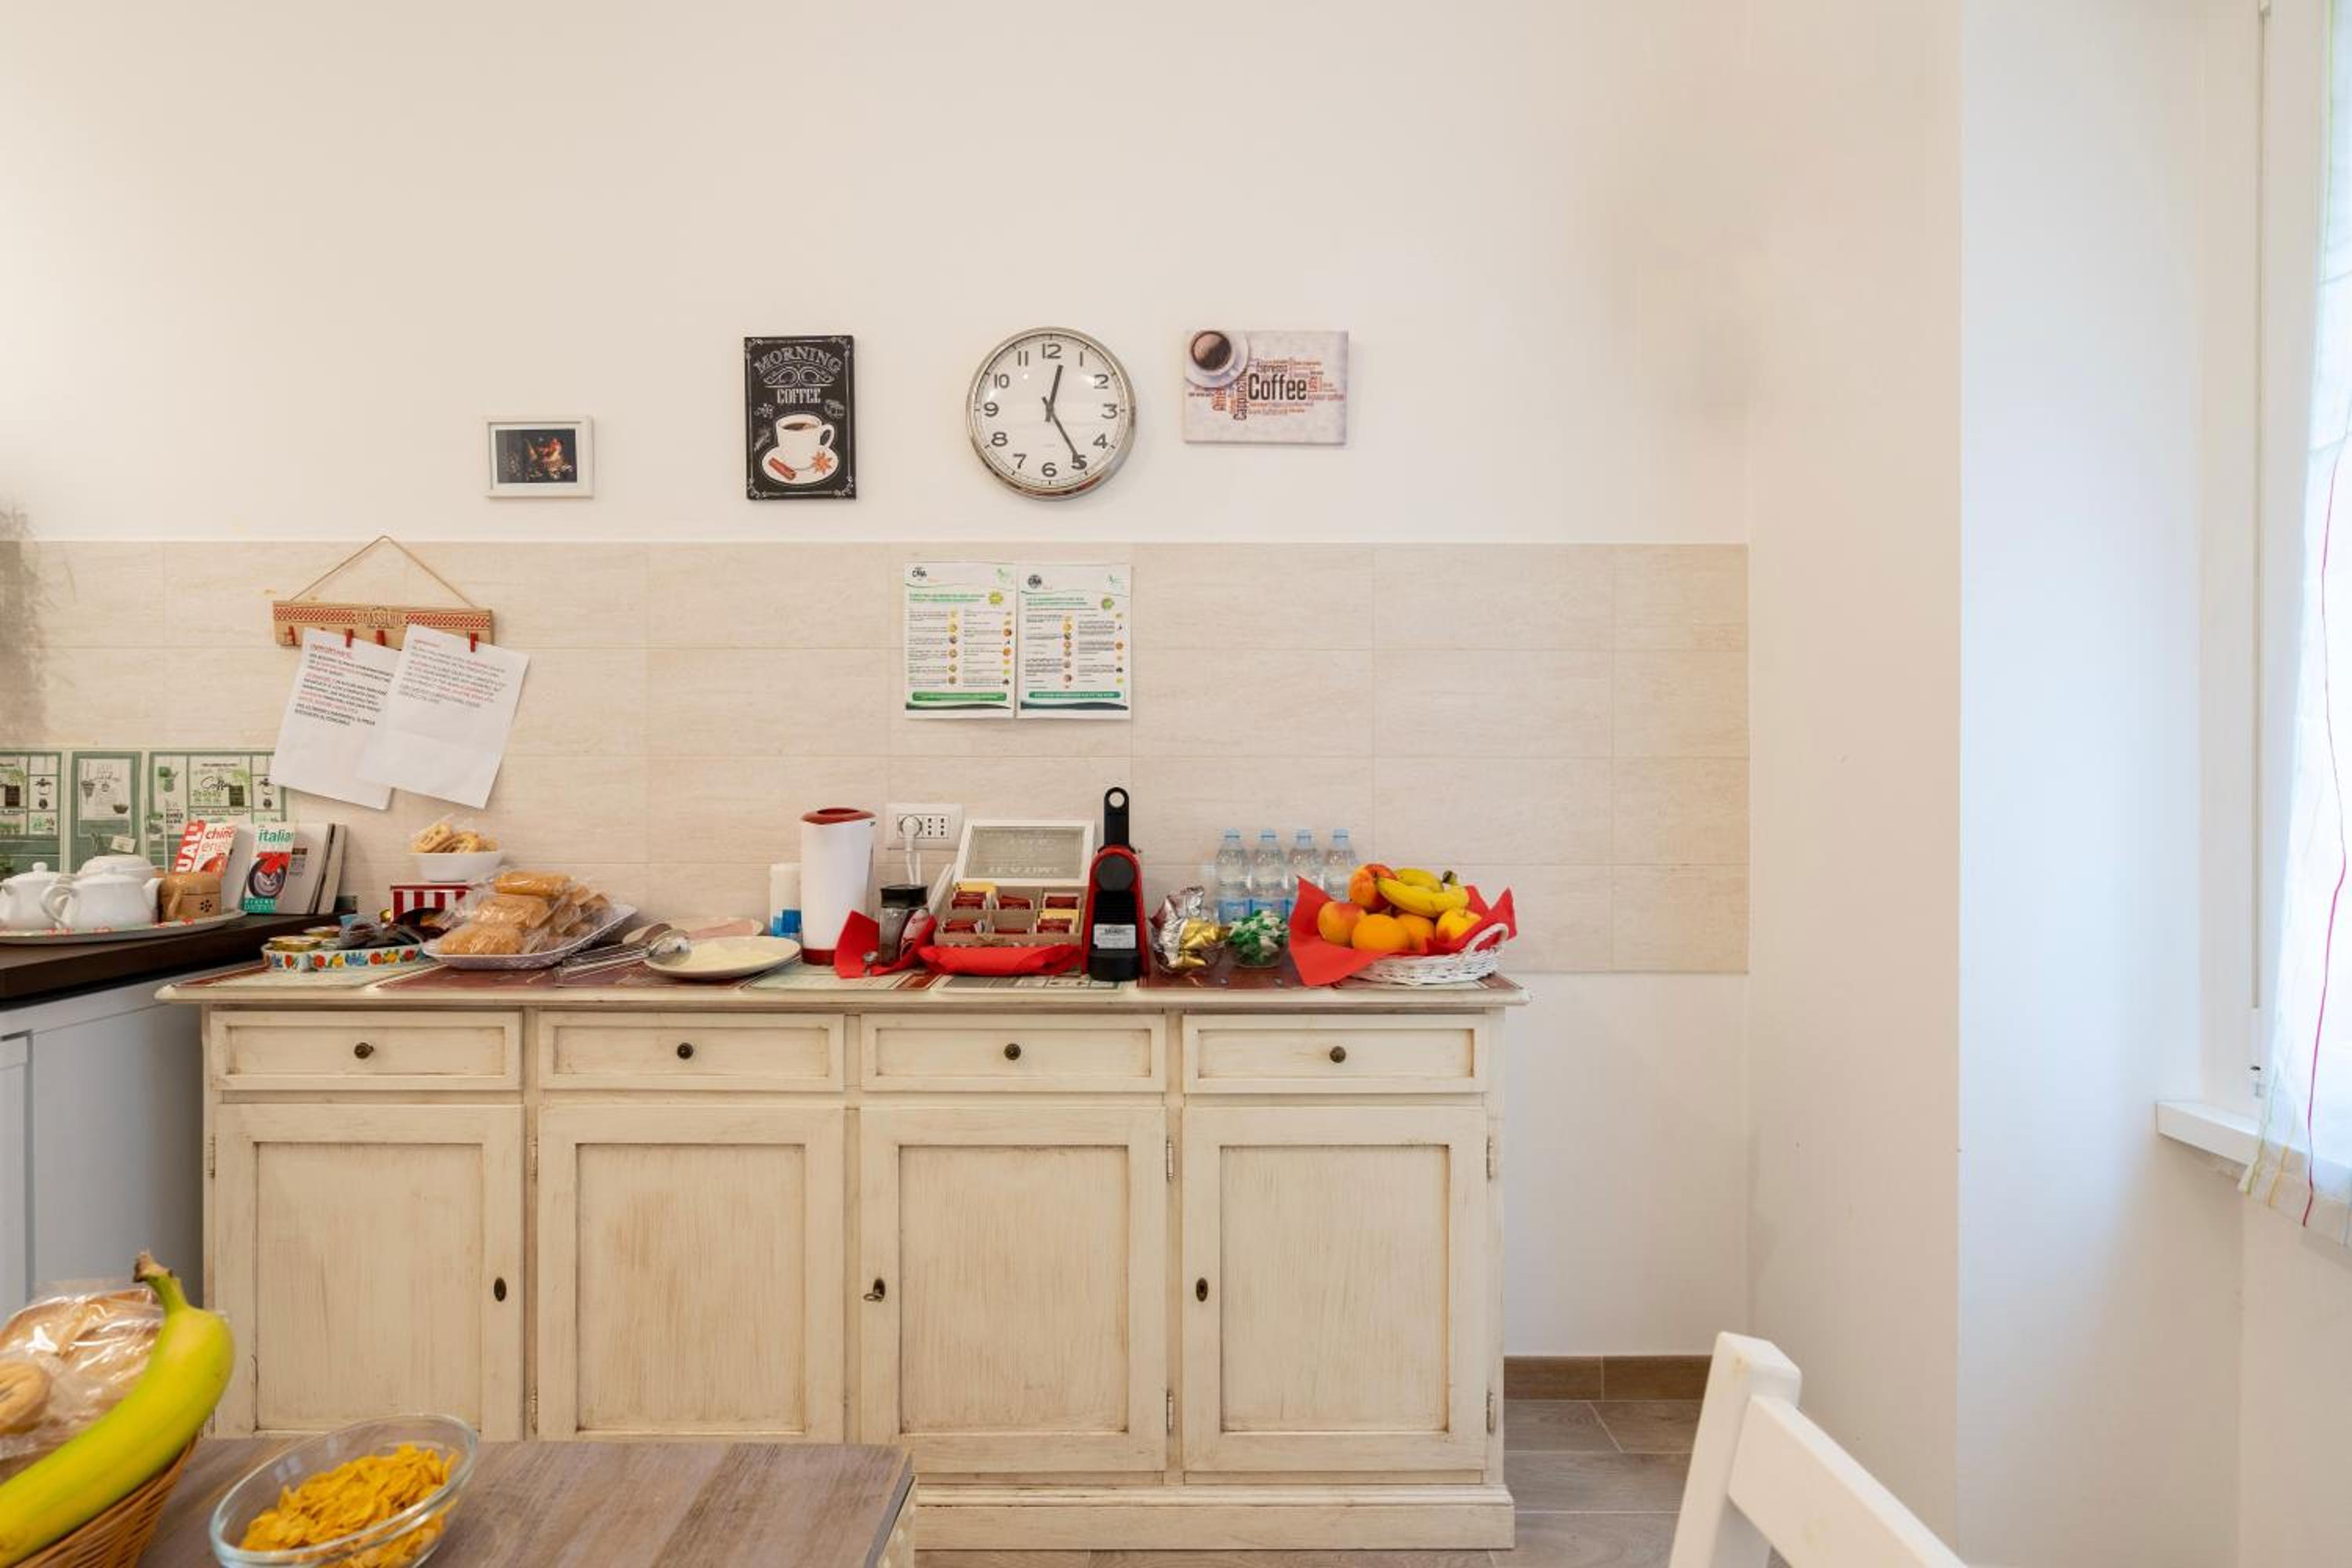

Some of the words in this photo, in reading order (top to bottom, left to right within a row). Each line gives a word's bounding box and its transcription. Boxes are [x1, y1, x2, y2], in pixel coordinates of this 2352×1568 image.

[1018, 350, 1029, 366] 11
[1042, 343, 1062, 359] 12
[1079, 350, 1083, 367] 1
[753, 346, 843, 374] MORNING
[994, 374, 1010, 389] 10
[1094, 374, 1109, 390] 2
[1247, 372, 1307, 401] Coffee
[777, 388, 821, 404] COFFEE
[983, 401, 1000, 417] 9
[1102, 403, 1118, 419] 3
[991, 432, 1008, 447] 8
[1092, 434, 1109, 449] 4
[1013, 453, 1027, 469] 7
[1071, 454, 1087, 470] 5
[1041, 462, 1058, 477] 6
[258, 828, 295, 844] italia
